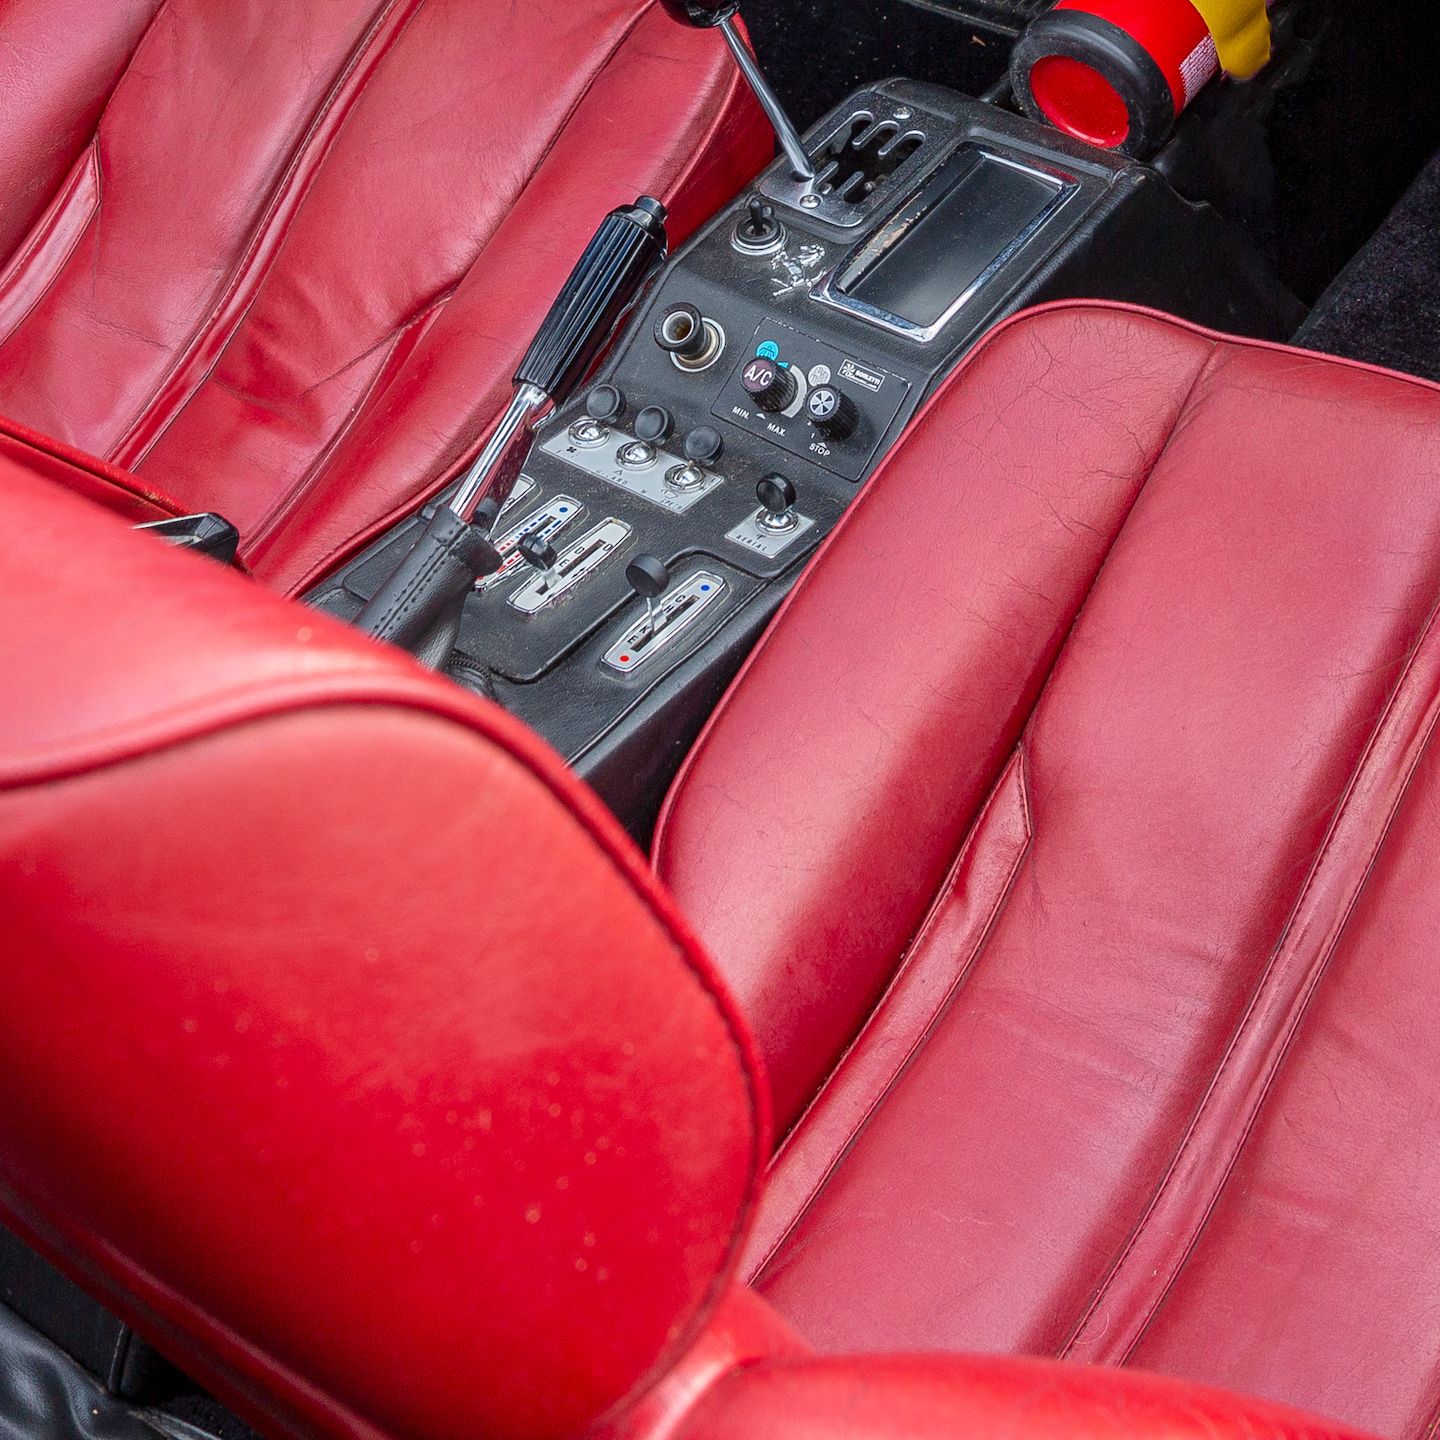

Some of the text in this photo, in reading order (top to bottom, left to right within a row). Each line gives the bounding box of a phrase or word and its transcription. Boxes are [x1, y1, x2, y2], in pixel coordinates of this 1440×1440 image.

[744, 364, 773, 387] A/C
[731, 405, 750, 420] MIN.
[766, 422, 786, 437] MAX.
[809, 442, 831, 457] STOP
[735, 534, 768, 552] AERIAL
